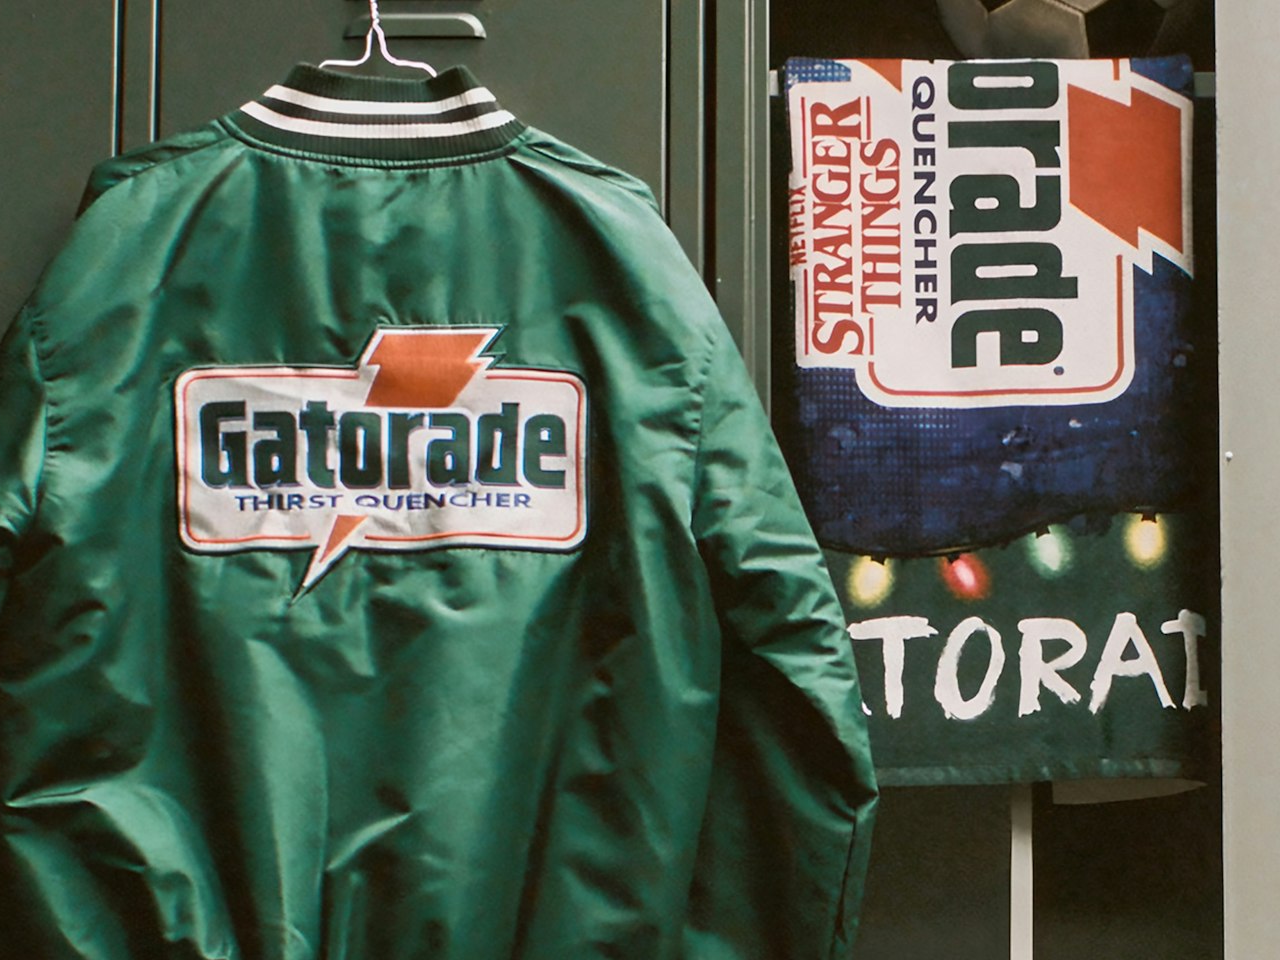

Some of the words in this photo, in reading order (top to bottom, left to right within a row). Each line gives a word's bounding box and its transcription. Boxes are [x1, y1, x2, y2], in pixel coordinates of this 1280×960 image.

[789, 185, 808, 266] NETFLIX
[810, 99, 865, 355] STRANGER
[859, 138, 902, 313] THINGS
[912, 76, 938, 324] QUENCHER
[199, 400, 567, 490] Gatorade
[235, 494, 344, 512] THIRST
[354, 492, 532, 511] QUENCHER
